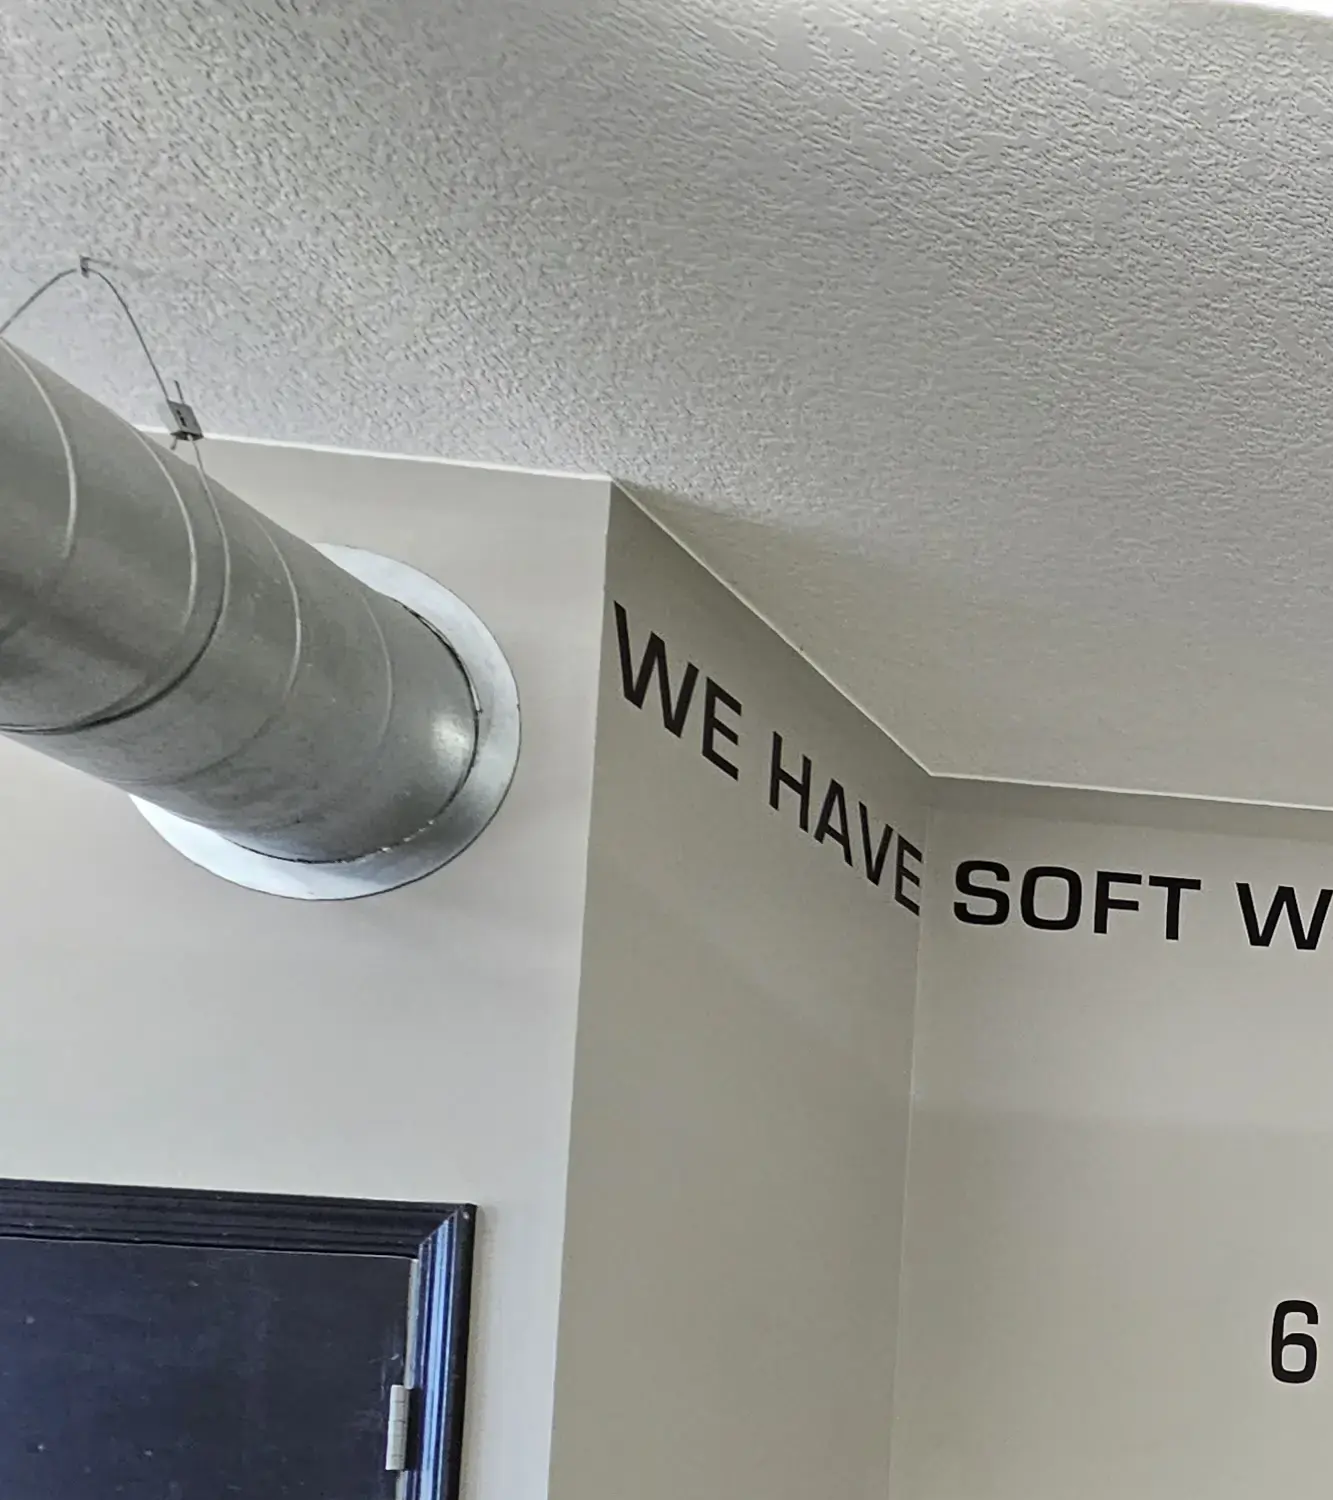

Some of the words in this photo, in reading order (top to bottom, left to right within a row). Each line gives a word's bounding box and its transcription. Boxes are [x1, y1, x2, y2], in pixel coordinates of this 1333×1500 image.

[613, 600, 742, 782] WE
[769, 731, 923, 917] HAVE
[953, 859, 1202, 941] SOFT
[1271, 1299, 1319, 1384] 6
